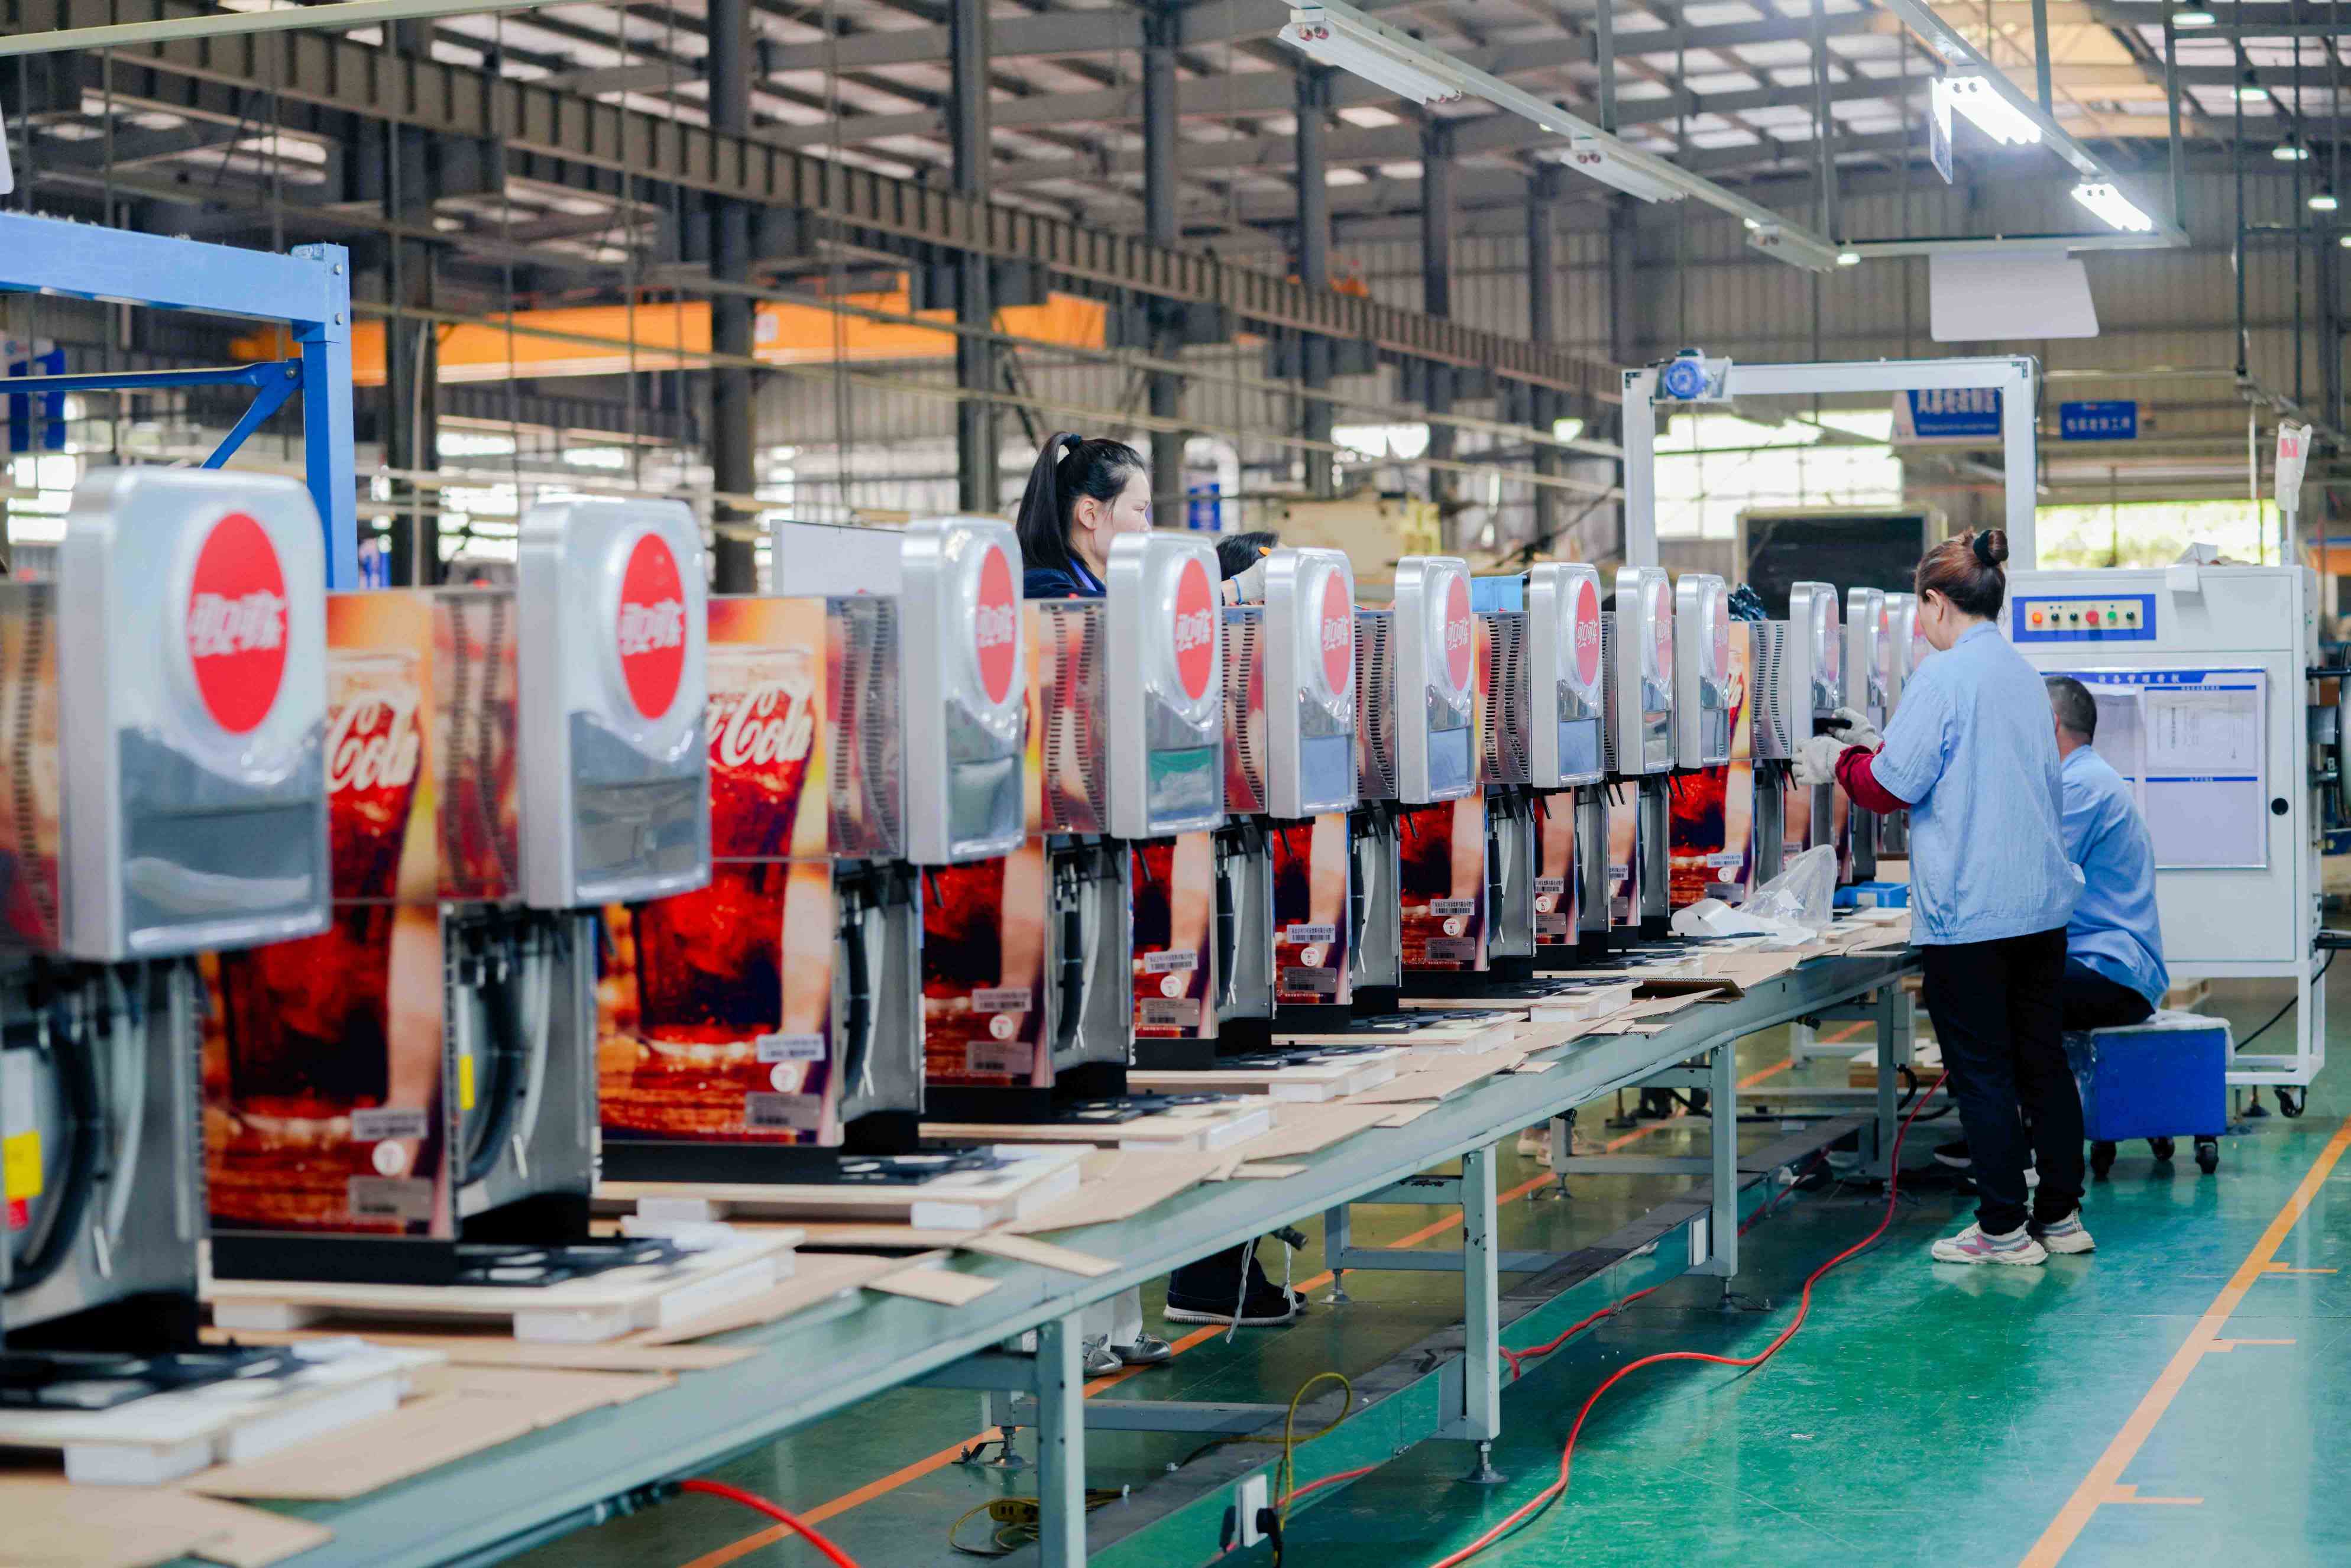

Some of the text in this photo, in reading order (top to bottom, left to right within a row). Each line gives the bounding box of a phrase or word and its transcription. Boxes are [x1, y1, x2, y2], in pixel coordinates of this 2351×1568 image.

[1447, 617, 1470, 650] 可口可乐
[1577, 619, 1598, 648] 可口可乐
